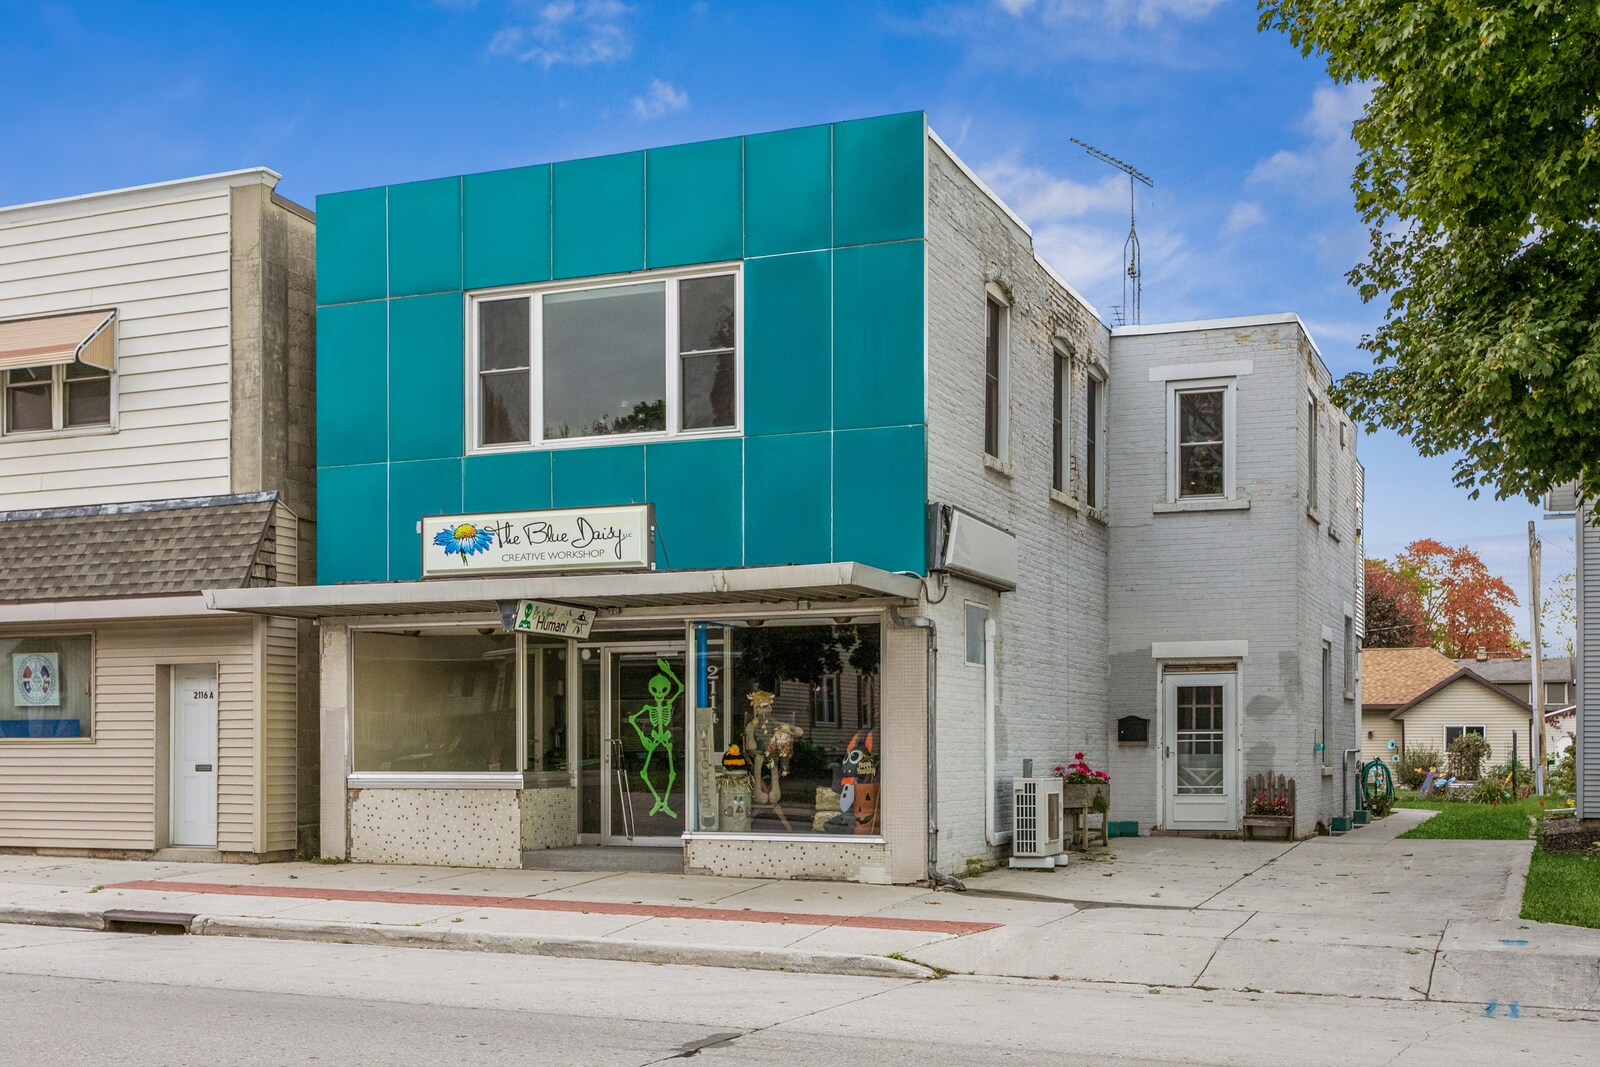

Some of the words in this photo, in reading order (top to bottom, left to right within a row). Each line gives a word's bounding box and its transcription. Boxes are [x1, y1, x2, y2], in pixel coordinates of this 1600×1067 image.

[484, 520, 521, 548] The
[523, 521, 569, 545] Blue
[571, 517, 626, 560] Daisy
[502, 552, 546, 562] CREATIVE
[548, 549, 605, 560] WORKSHOP
[536, 615, 570, 633] Human!
[193, 691, 208, 700] 2116
[209, 691, 214, 699] A
[697, 724, 711, 809] WITCHES
